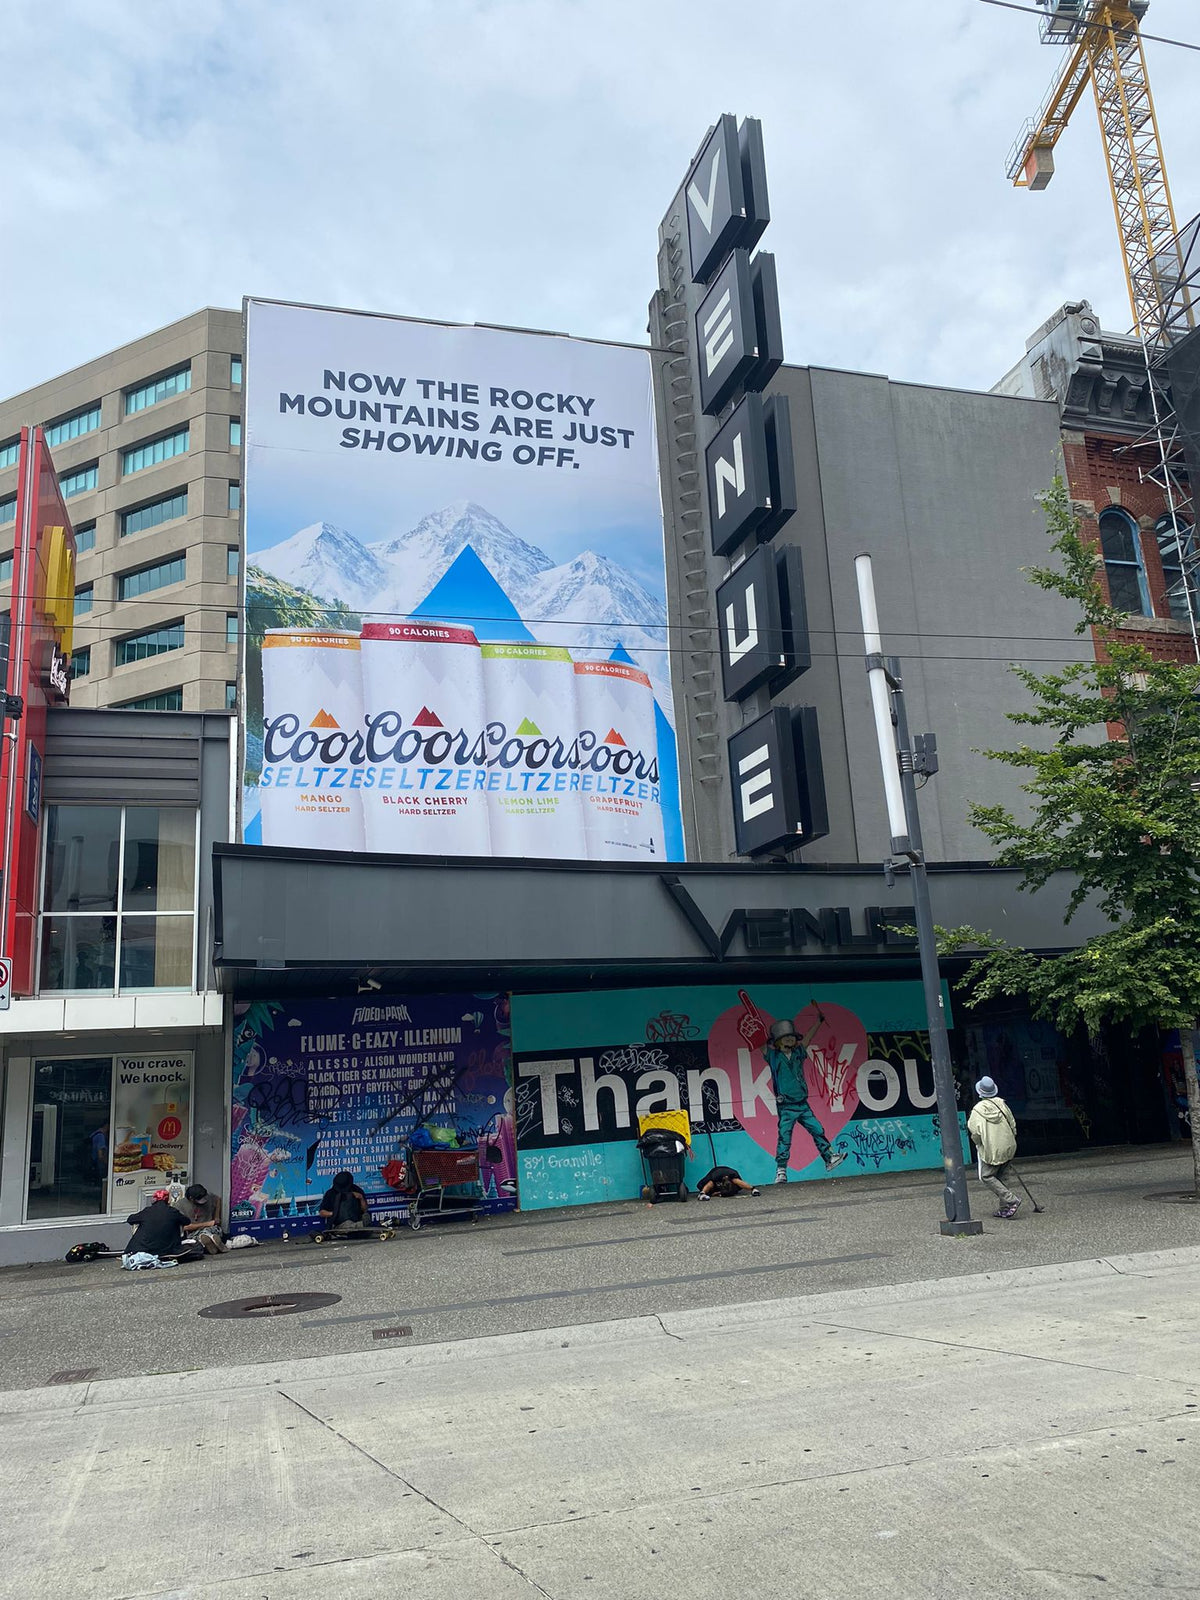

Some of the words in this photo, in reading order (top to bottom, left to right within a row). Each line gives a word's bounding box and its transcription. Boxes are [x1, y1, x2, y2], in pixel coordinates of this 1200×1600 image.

[323, 369, 407, 397] NOW
[416, 378, 480, 405] THE
[489, 387, 595, 417] ROCKY
[279, 392, 480, 432] MOUNTAINS
[489, 415, 553, 440] ARE
[562, 422, 635, 449] JUST
[339, 427, 502, 462] SHOWING
[512, 444, 580, 469] OFF.
[686, 147, 773, 825] VENUE
[304, 636, 350, 645] CALORIES
[389, 627, 400, 635] 90
[403, 628, 450, 638] CALORIES
[494, 647, 504, 655] 90
[505, 648, 548, 657] CALORIES
[584, 664, 594, 672] 90
[595, 665, 631, 676] CALORIES
[263, 713, 366, 766] Coor
[364, 710, 488, 766] Coors
[261, 766, 365, 789] SELTZE
[363, 767, 486, 791] SELTZER
[488, 772, 580, 792] ELTZER
[580, 773, 660, 803] ELTZER
[300, 794, 342, 803] MANGO
[383, 796, 421, 805] BLACK
[425, 797, 468, 805] CHERRY
[498, 797, 533, 806] LEMON
[537, 797, 560, 805] LIME
[589, 796, 643, 808] GRAPEFRUIT
[423, 808, 457, 816] SELTZER
[614, 807, 640, 816] SELTZER
[659, 874, 918, 962] VENUE
[385, 1004, 413, 1023] PARK
[300, 1034, 346, 1053] FLUME
[352, 1031, 399, 1050] G-EAZY
[404, 1027, 462, 1047] ILLENIUM
[121, 1059, 145, 1070] You
[147, 1058, 186, 1069] crave.
[308, 1057, 358, 1070] ALESSO
[364, 1055, 395, 1067] ALISON
[398, 1051, 455, 1065] WONDERLAND
[120, 1073, 140, 1084] We
[143, 1071, 186, 1083] knock.
[308, 1072, 335, 1084] BLACK
[336, 1071, 360, 1082] TIGER
[361, 1069, 377, 1080] SEX
[379, 1066, 415, 1079] MACHINE
[342, 1083, 362, 1095] CITY
[518, 1047, 778, 1136] Thank
[805, 1043, 938, 1113] You
[334, 1128, 361, 1138] SHAKE
[150, 1143, 184, 1151] McDelivery
[316, 1149, 339, 1158] JUELZ
[371, 1144, 394, 1153] SHANE
[547, 1150, 603, 1168] Granville
